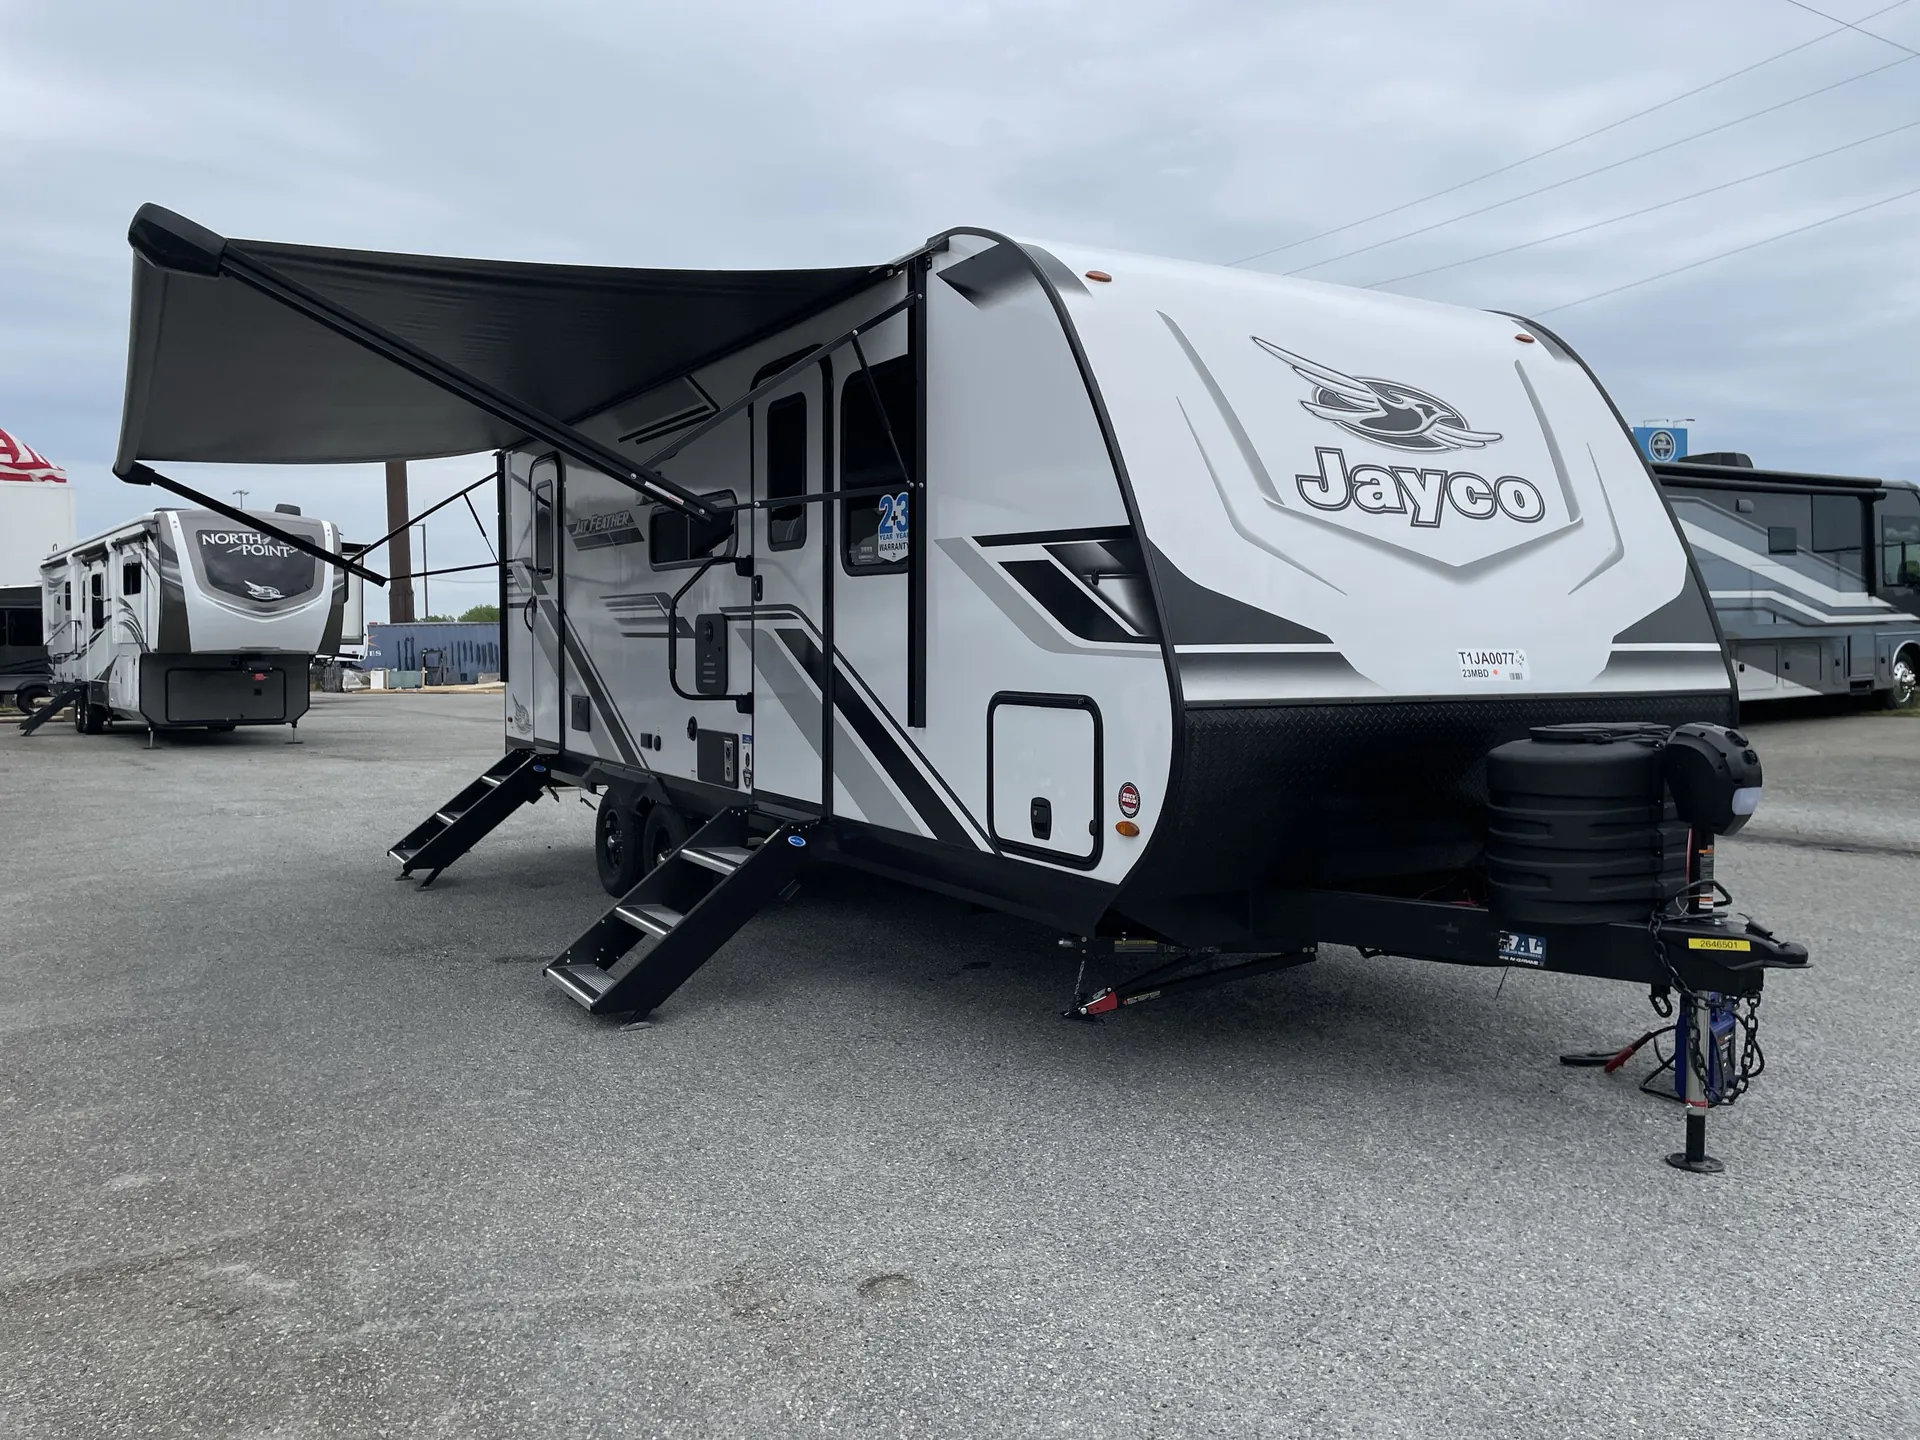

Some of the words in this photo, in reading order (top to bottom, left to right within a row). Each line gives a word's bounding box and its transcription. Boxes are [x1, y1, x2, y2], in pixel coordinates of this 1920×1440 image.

[1295, 446, 1546, 528] Jayco
[590, 512, 630, 532] FEATHER
[202, 533, 261, 545] NORTH
[880, 533, 893, 541] YEAR
[896, 531, 909, 539] YEA
[242, 544, 290, 558] POINT
[1462, 669, 1489, 678] 23MBD
[1700, 940, 1738, 949] 2646501
